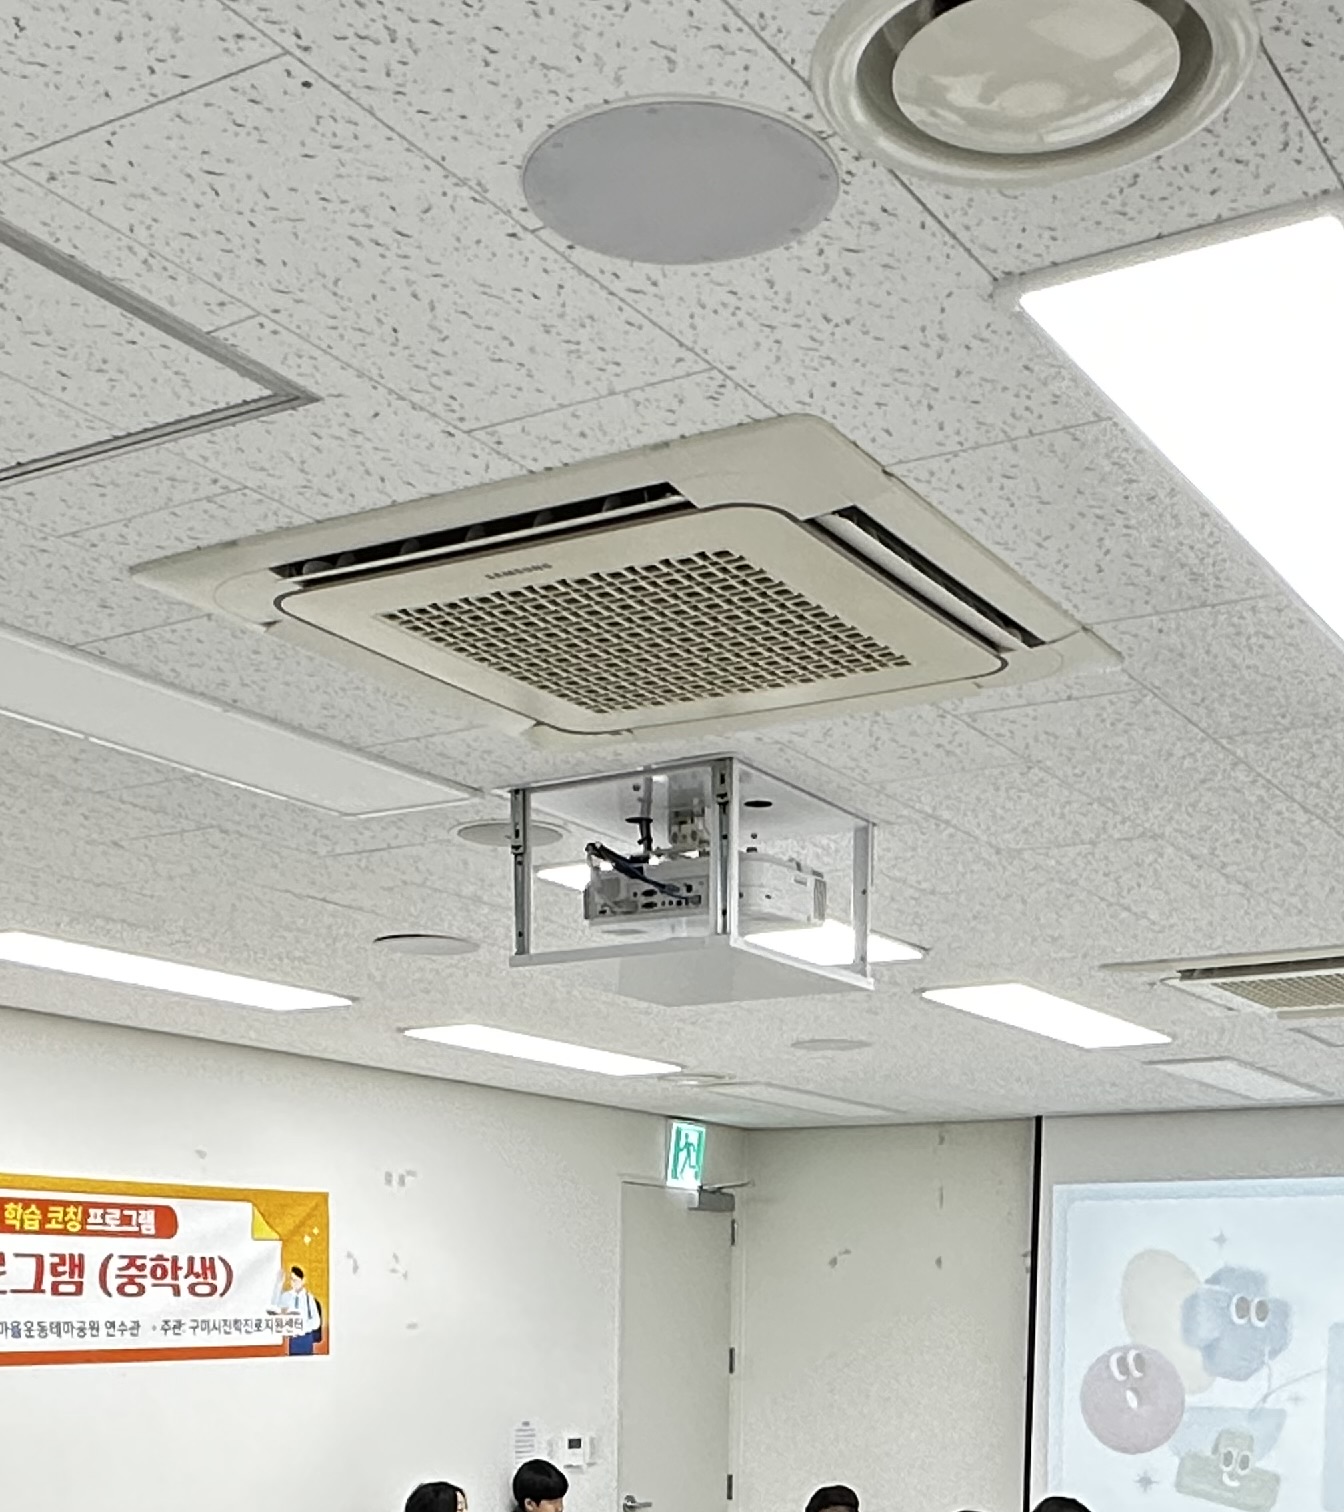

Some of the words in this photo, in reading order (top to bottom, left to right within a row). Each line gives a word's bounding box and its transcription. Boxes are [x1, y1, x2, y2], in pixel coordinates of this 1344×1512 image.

[485, 563, 552, 579] SAMSUNG
[4, 1203, 40, 1232] 학습
[44, 1206, 83, 1232] 코칭
[86, 1208, 157, 1236] 프로그램
[98, 1252, 235, 1298] (중학생)
[104, 1319, 142, 1339] 연수관
[160, 1318, 187, 1337] 주관:
